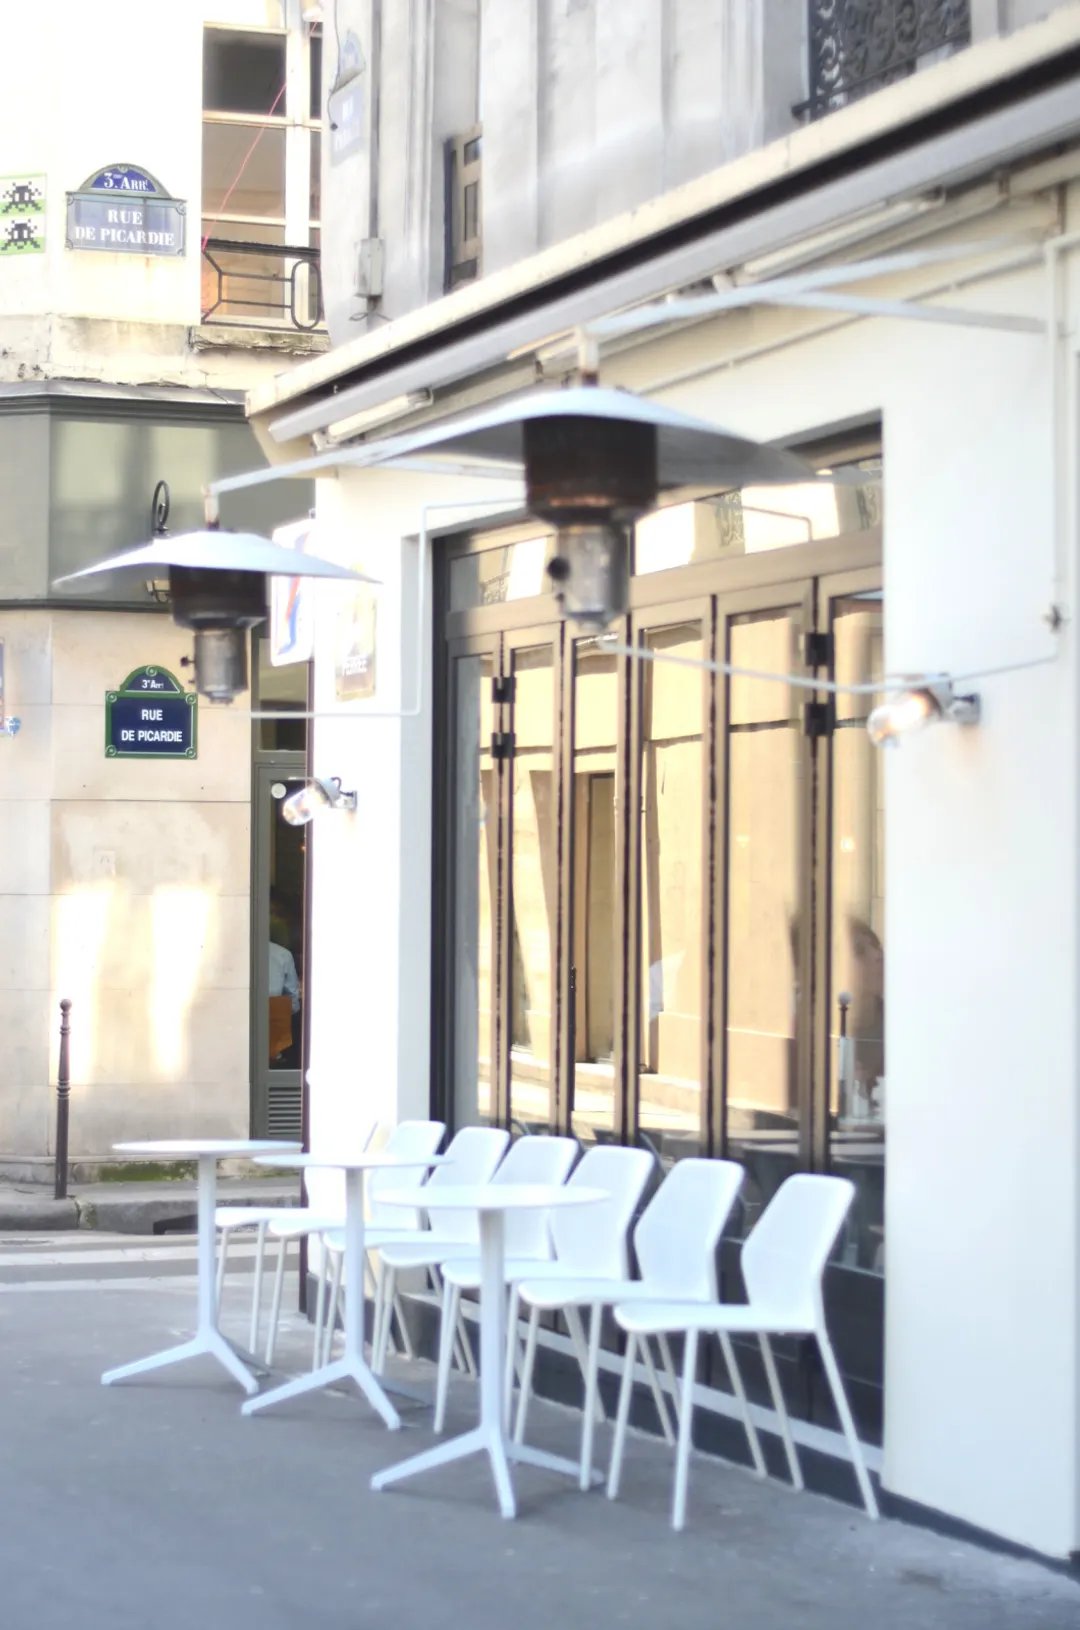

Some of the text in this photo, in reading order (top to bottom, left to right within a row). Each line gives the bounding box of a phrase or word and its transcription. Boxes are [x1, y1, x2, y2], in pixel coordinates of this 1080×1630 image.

[107, 209, 143, 225] RUE
[75, 226, 175, 246] DE PICARDIE
[141, 709, 163, 721] RUE
[121, 730, 183, 742] DE PICARDIE
